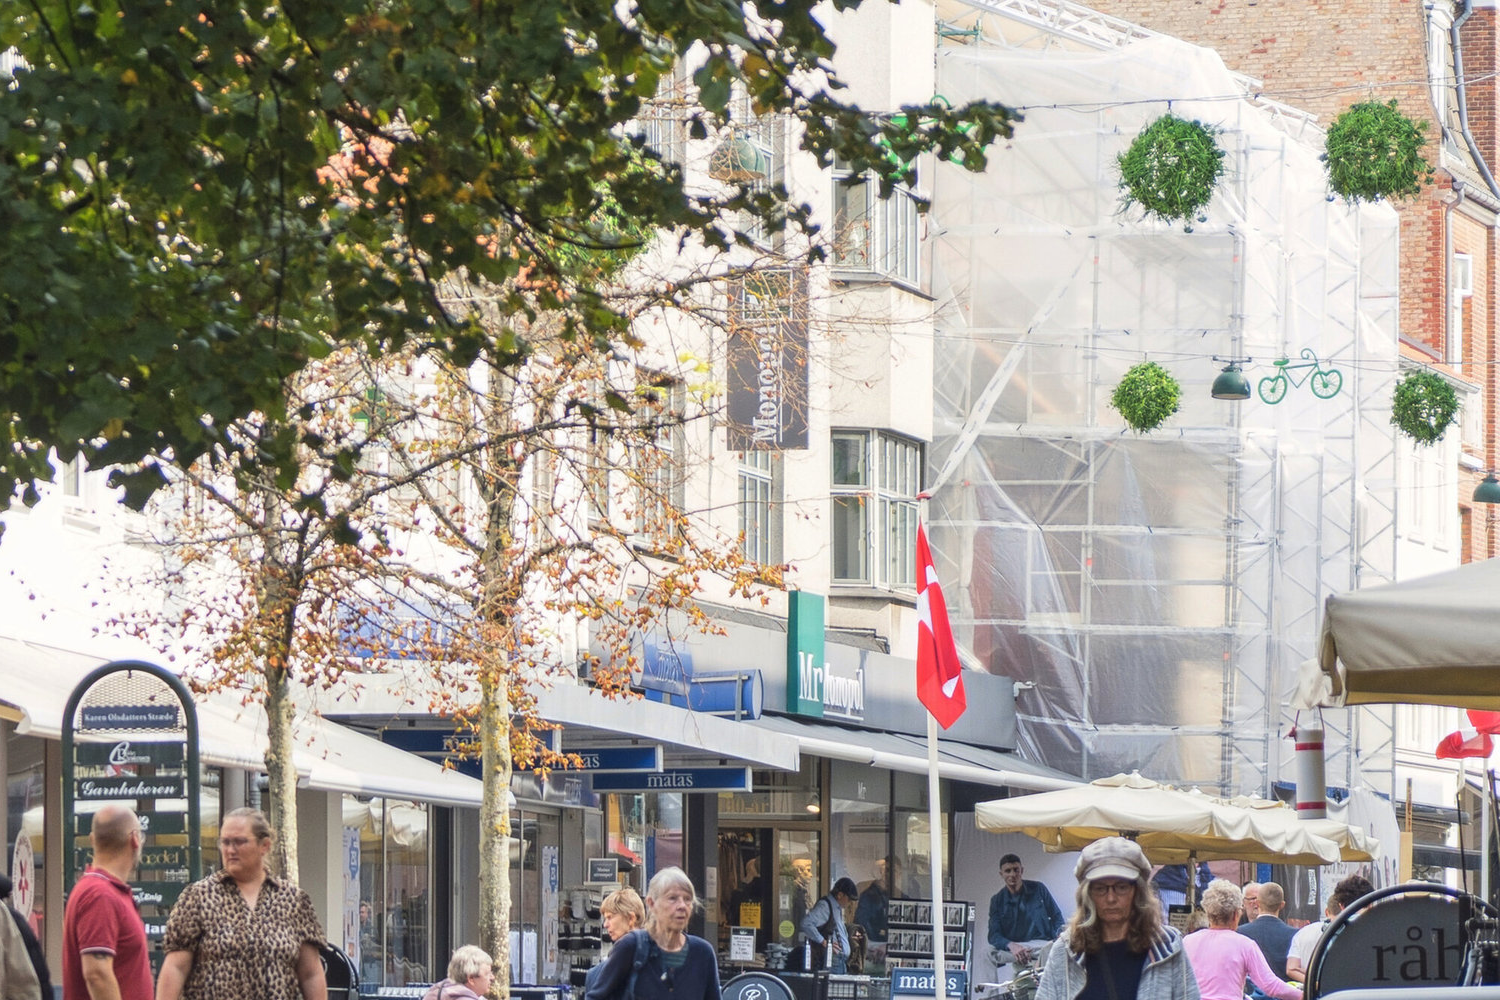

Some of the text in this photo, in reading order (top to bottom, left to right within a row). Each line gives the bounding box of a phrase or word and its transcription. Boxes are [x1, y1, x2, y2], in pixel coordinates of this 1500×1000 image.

[799, 651, 823, 702] Mr
[85, 712, 174, 721] Karen Olsdatters Stræde
[648, 772, 693, 787] matas
[899, 973, 957, 990] mats
